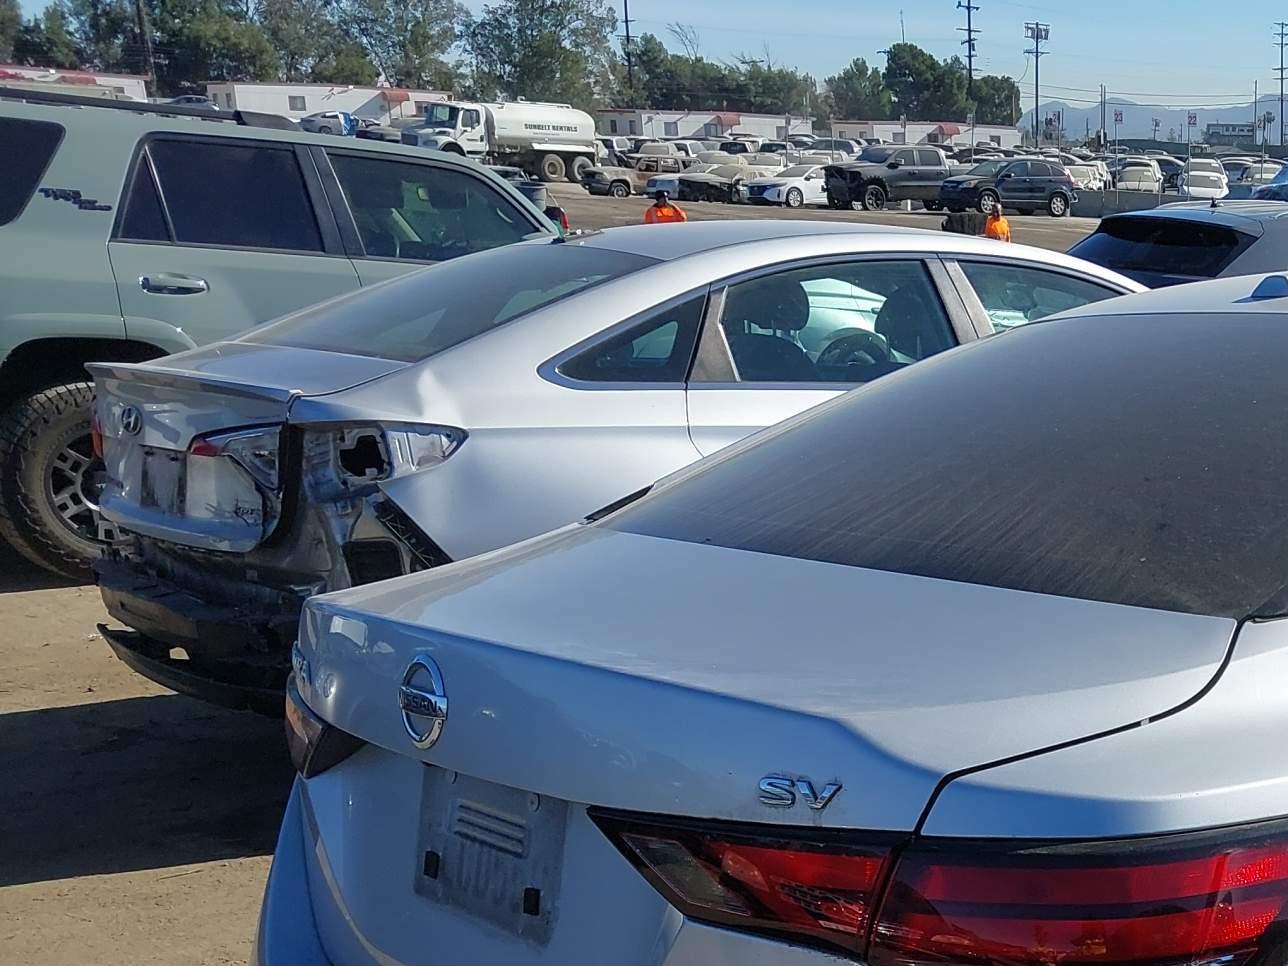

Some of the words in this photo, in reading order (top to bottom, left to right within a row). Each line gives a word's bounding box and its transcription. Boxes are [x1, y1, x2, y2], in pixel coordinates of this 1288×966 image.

[1187, 115, 1197, 125] 22
[523, 123, 551, 131] SUNBELT
[551, 124, 578, 132] RENTALS
[759, 776, 843, 809] SV
